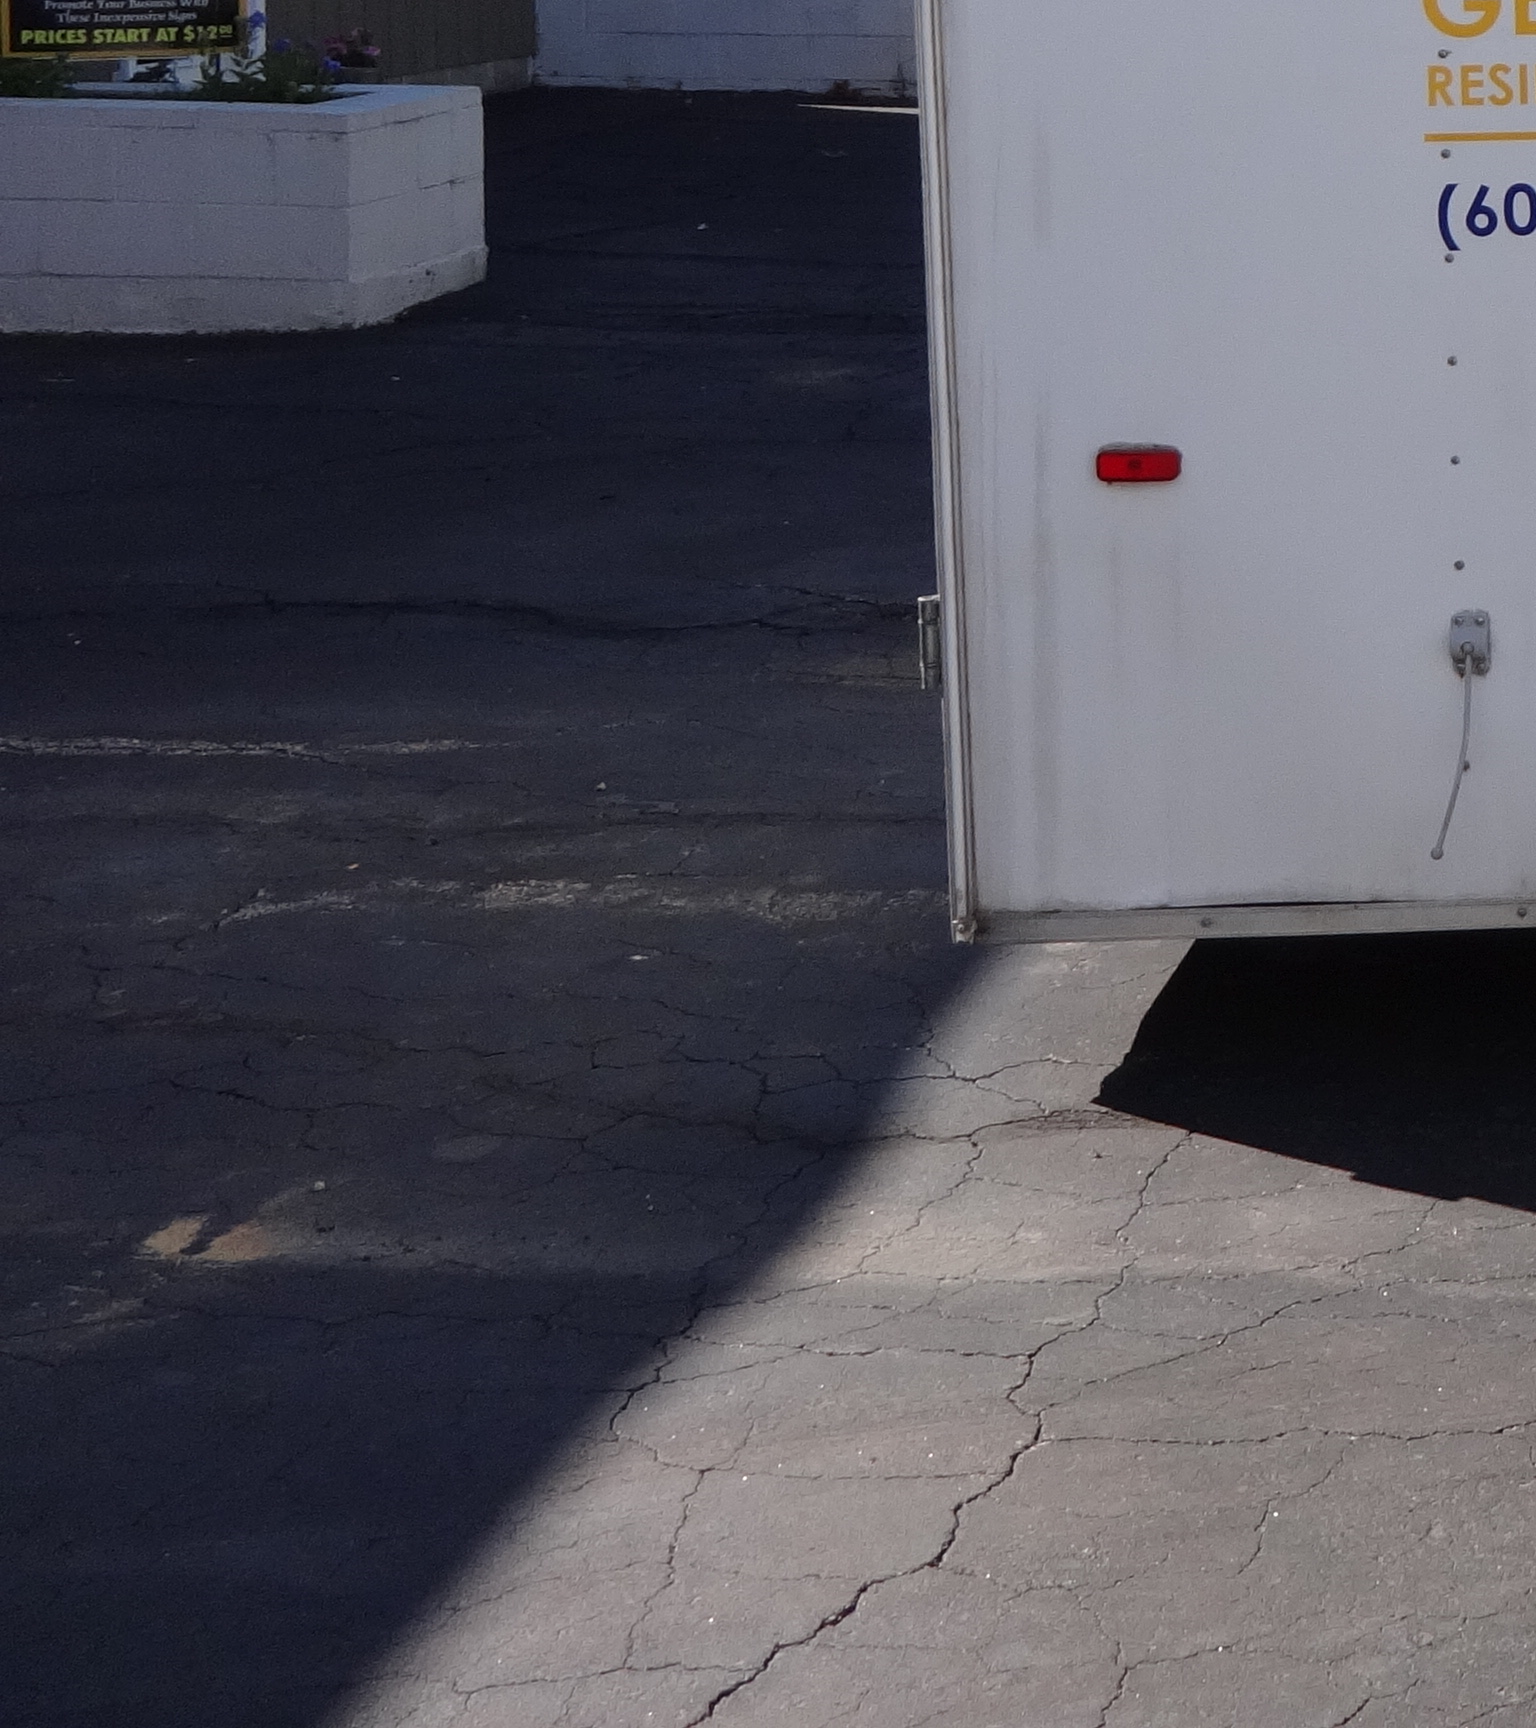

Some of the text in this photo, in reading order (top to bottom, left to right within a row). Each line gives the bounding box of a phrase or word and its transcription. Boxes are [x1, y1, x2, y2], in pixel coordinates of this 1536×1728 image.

[45, 0, 93, 10] Promote
[98, 0, 125, 10] Your
[56, 9, 198, 24] These Inexpensive Signs
[21, 29, 87, 44] PRICES
[93, 28, 150, 44] START
[155, 27, 179, 42] AT
